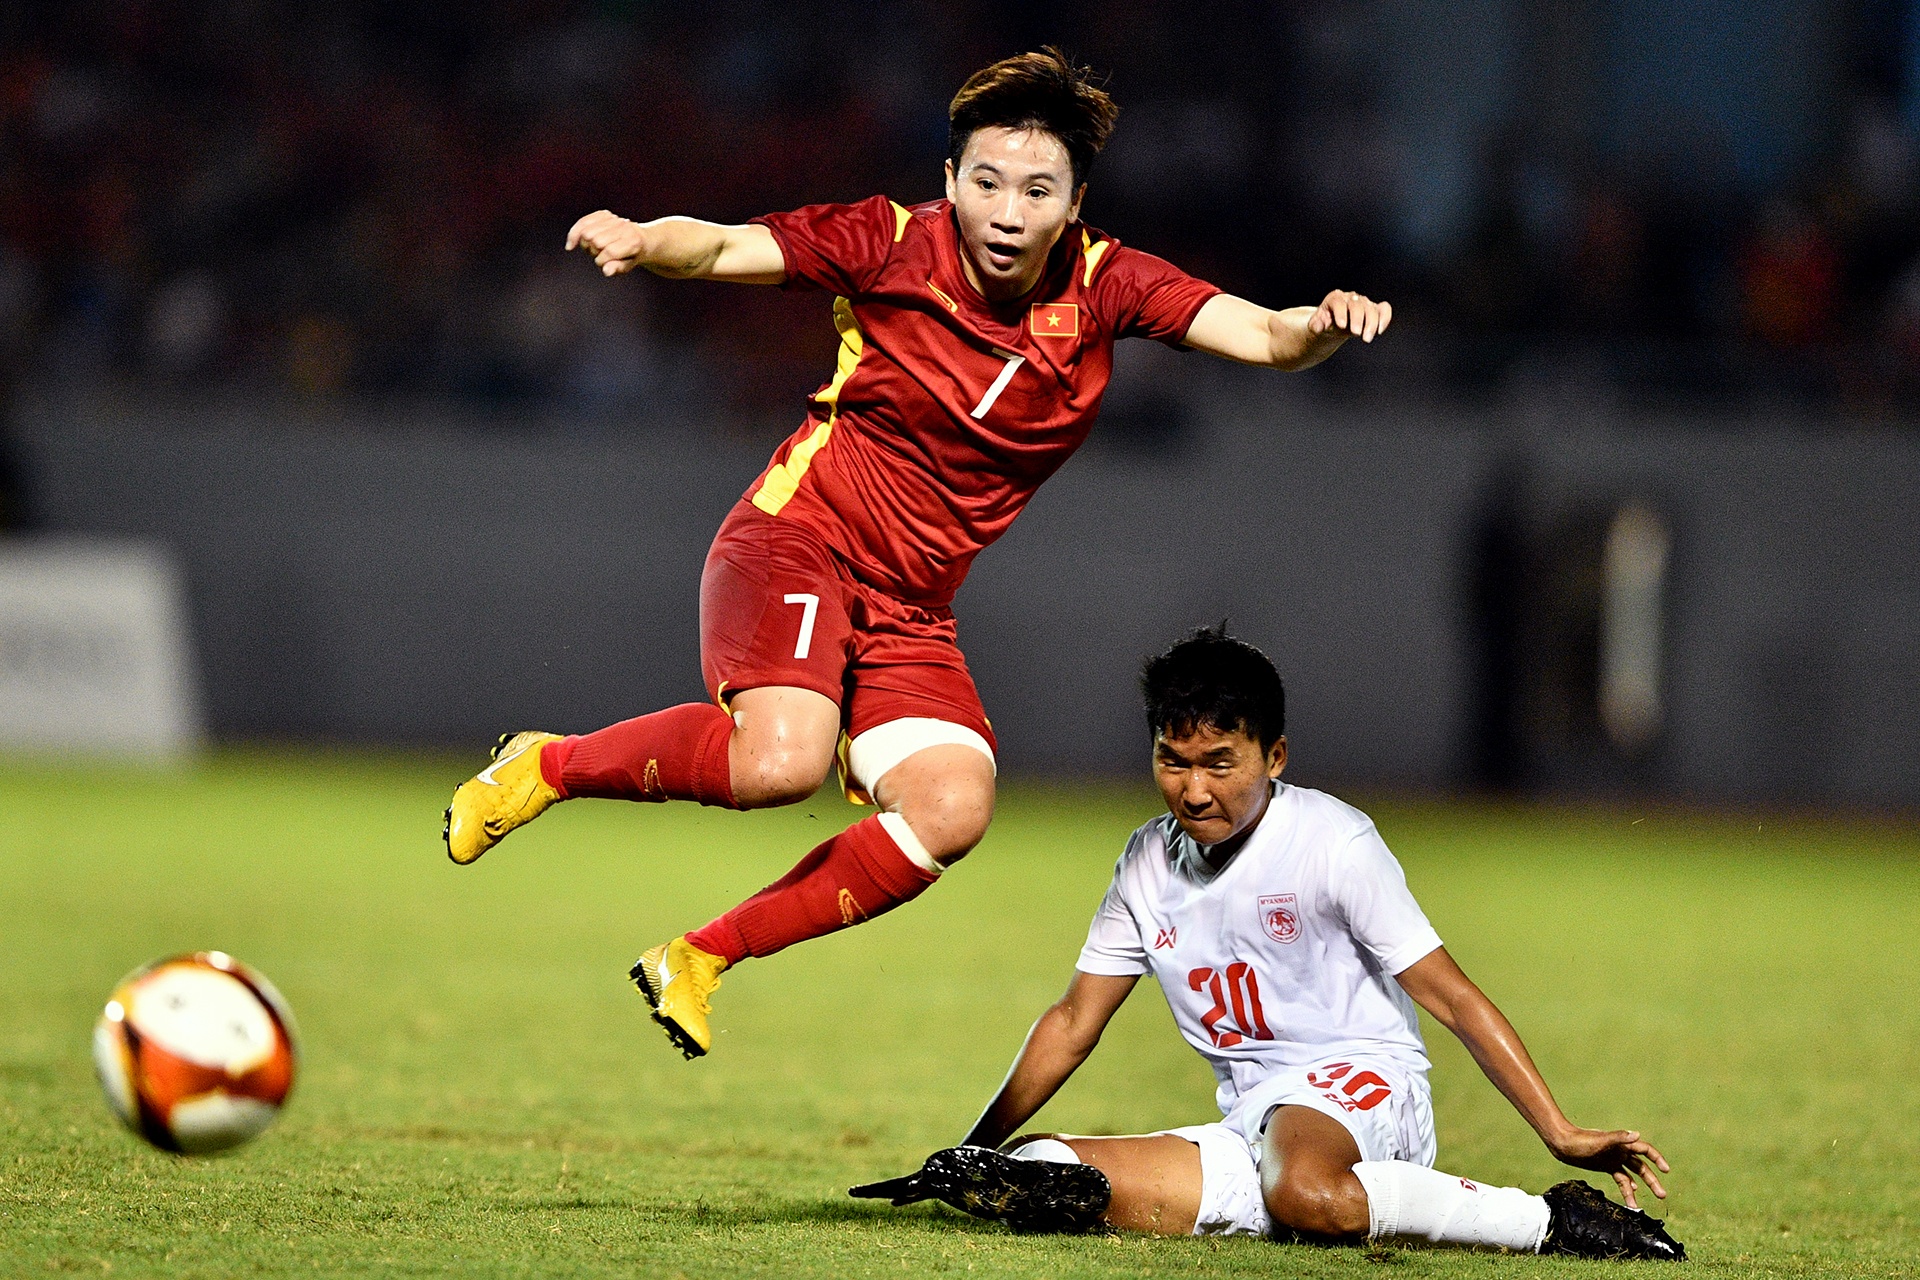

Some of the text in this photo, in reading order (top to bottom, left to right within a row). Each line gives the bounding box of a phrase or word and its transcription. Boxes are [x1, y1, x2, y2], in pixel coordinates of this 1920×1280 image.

[970, 347, 1026, 419] 7
[783, 593, 820, 659] 7
[1188, 962, 1275, 1048] 20
